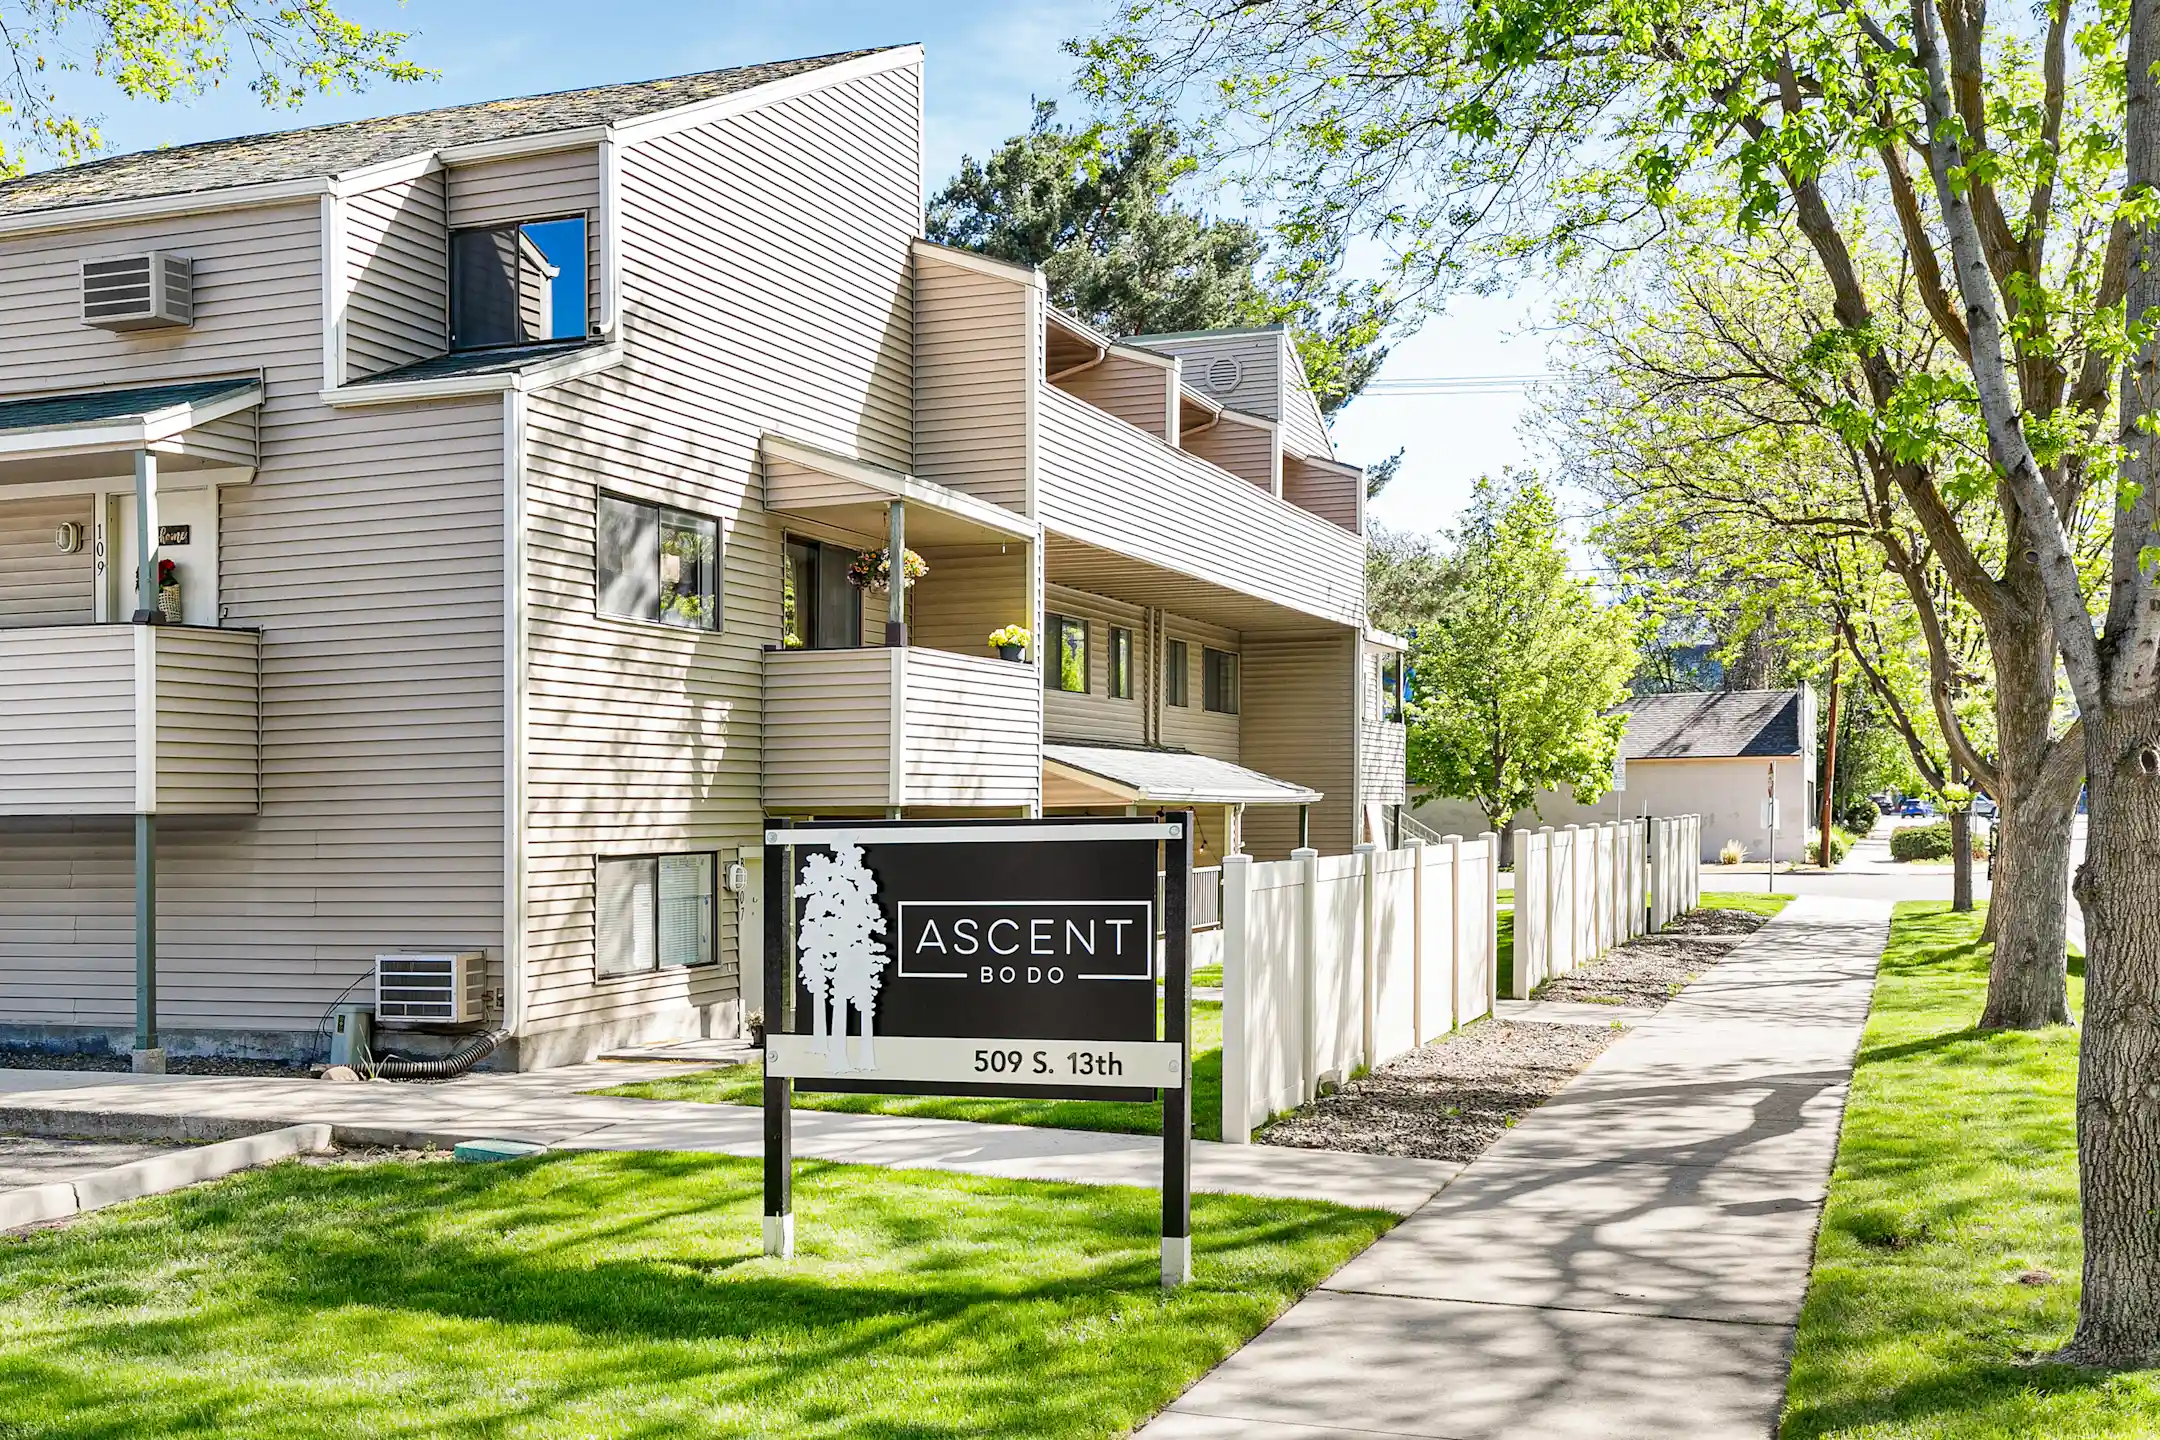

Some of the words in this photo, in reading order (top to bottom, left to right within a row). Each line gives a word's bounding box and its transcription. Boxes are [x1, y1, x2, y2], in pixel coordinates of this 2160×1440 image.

[916, 918, 1133, 955] ASCENT
[980, 966, 1016, 983] BO
[1027, 966, 1064, 984] DO
[974, 1050, 1023, 1073] 509
[1032, 1051, 1054, 1074] S.
[1067, 1052, 1123, 1076] 13th
